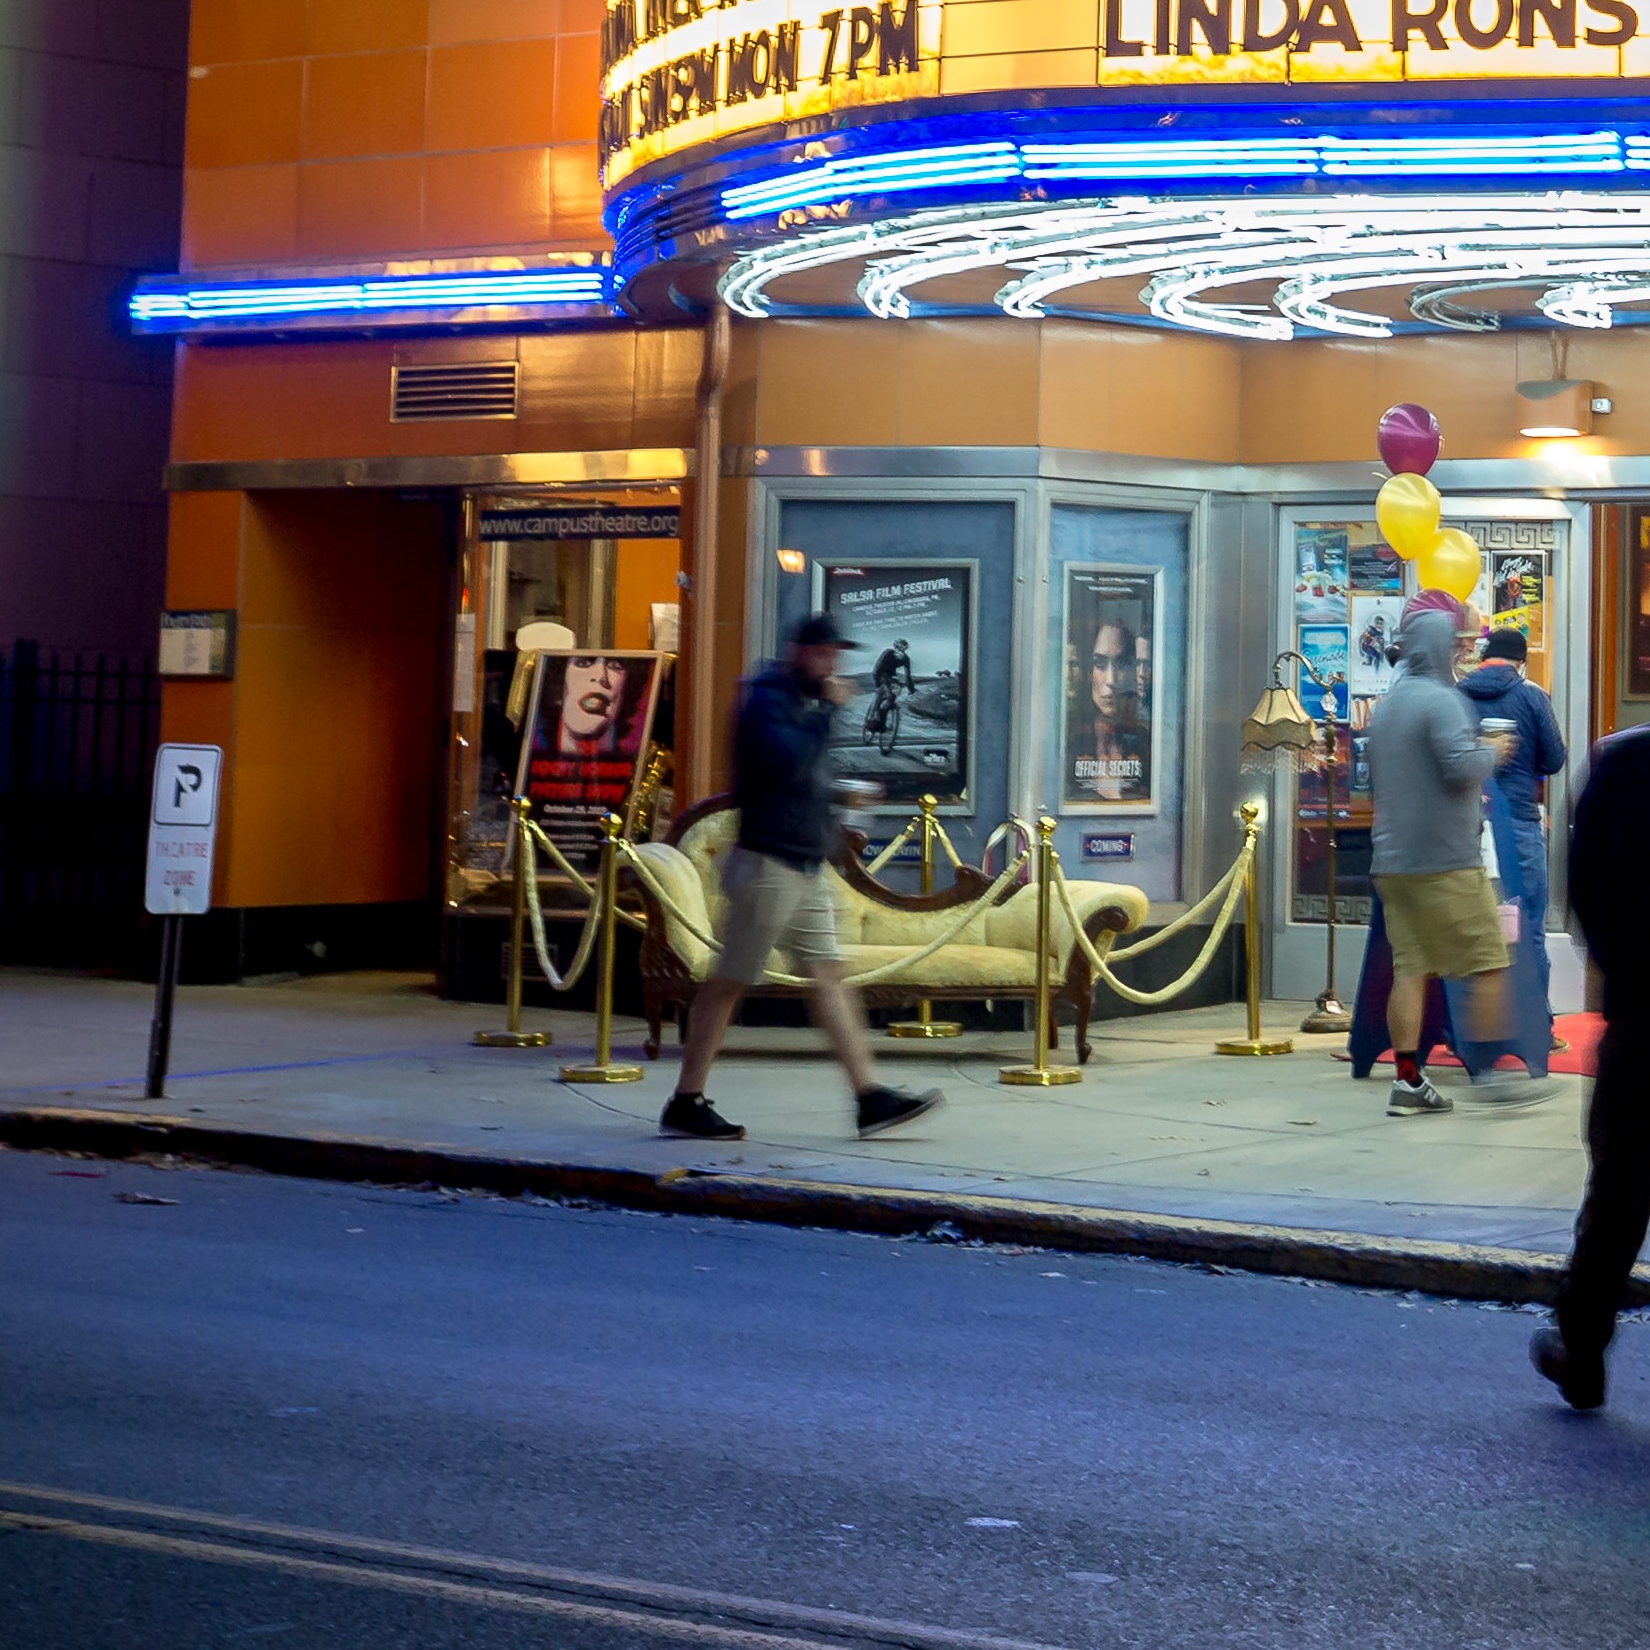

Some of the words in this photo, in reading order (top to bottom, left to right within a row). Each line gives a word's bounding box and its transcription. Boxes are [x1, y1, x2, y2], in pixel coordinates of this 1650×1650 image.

[726, 20, 800, 107] MON
[479, 511, 679, 538] www.campustheatre.org
[840, 590, 873, 605] SALSA
[876, 584, 901, 599] FILM
[903, 577, 952, 595] FESTIVAL
[1075, 760, 1107, 777] OFFICIAL
[1109, 760, 1141, 778] SECRETS
[174, 764, 203, 808] P
[155, 841, 208, 859] THEATRE
[1090, 840, 1125, 853] COMING
[164, 869, 197, 887] ZONE
